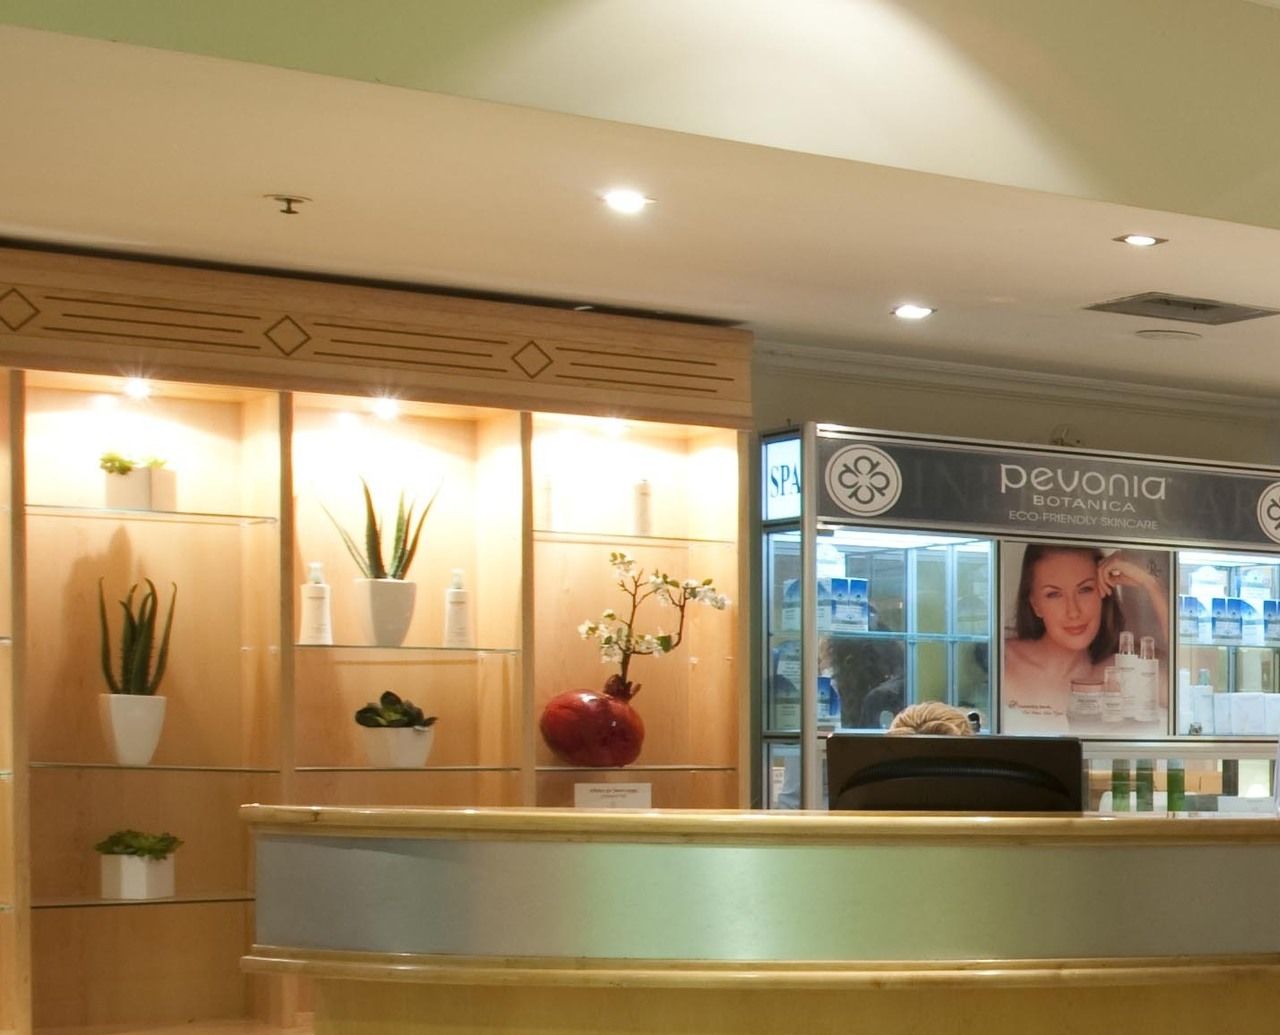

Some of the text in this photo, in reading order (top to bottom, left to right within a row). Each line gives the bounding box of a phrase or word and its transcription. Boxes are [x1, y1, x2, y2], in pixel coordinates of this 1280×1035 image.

[770, 464, 801, 498] SPA
[1000, 463, 1166, 500] pevonia
[1033, 494, 1136, 513] BOTANICA
[1008, 510, 1160, 531] ECO-FRIENDLY SKINCARE
